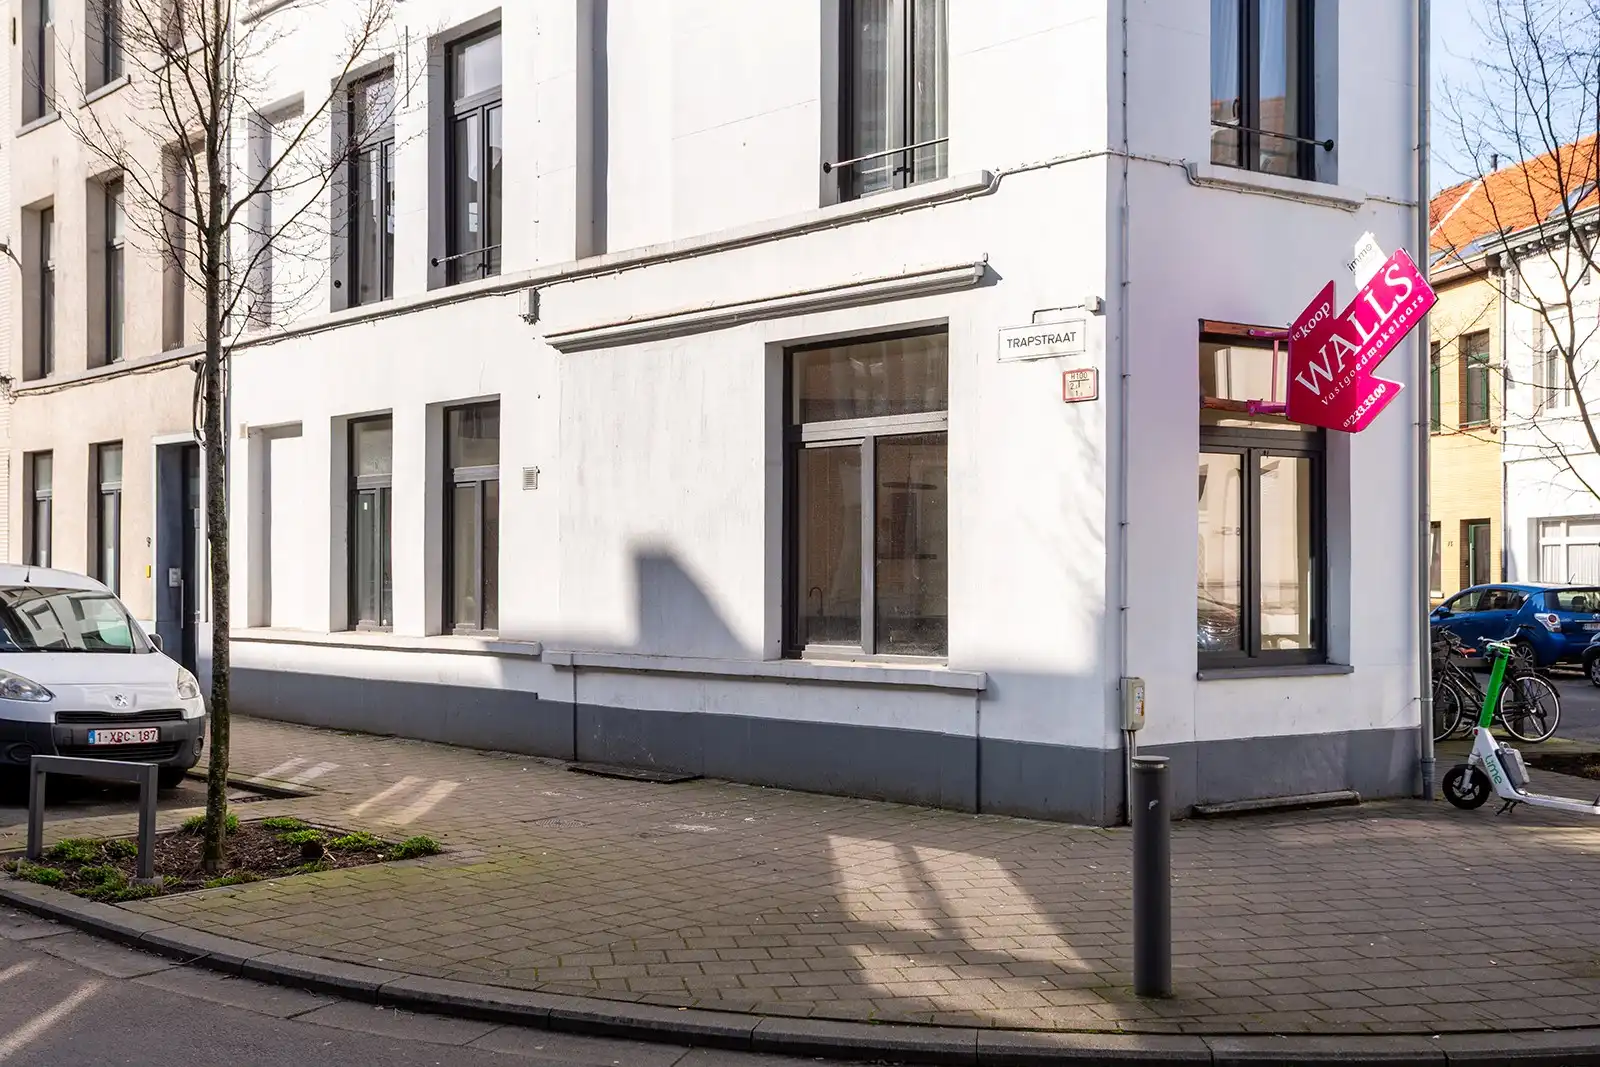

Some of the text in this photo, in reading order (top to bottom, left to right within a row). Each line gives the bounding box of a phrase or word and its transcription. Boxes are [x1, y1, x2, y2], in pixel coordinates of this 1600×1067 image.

[1007, 332, 1076, 348] TRAPSTRAAT
[1292, 302, 1330, 341] te koop
[1295, 263, 1413, 396] WALLS
